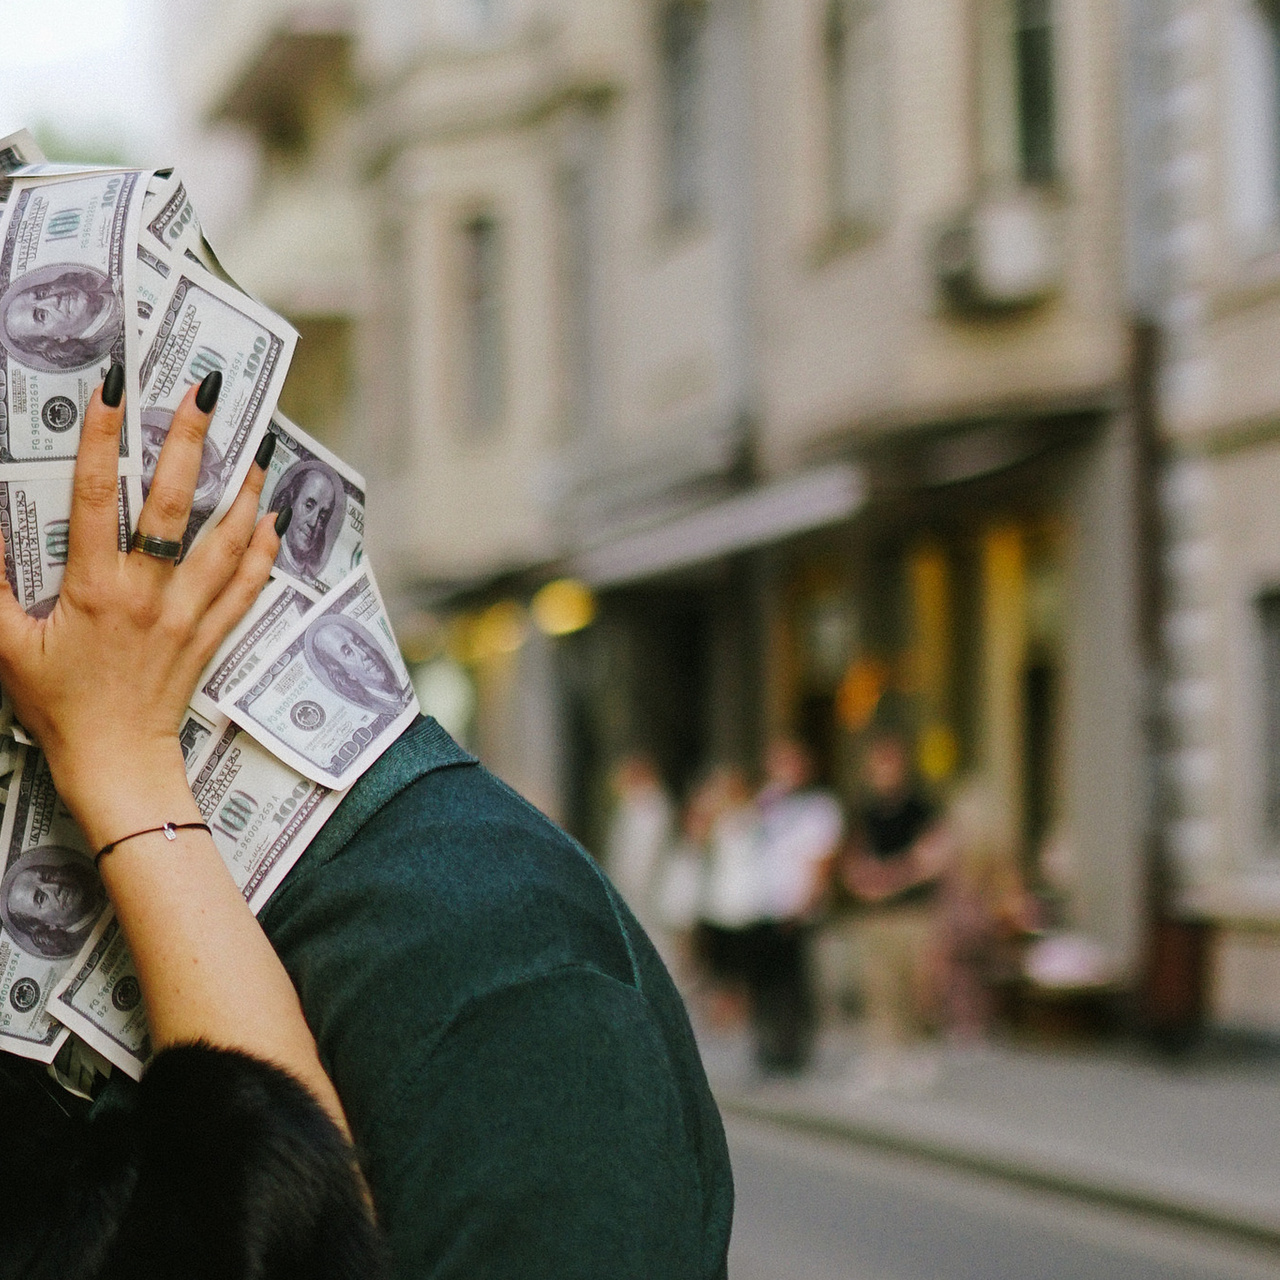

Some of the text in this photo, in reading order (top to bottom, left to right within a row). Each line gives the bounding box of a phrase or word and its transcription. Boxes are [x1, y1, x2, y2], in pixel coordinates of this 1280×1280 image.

[100, 177, 120, 208] 100
[240, 335, 268, 382] 100
[29, 382, 40, 436] 96003269
[224, 439, 241, 467] ONE
[235, 388, 262, 440] HUNDRED
[256, 341, 279, 389] DOLLARS
[30, 438, 40, 451] FG
[44, 437, 53, 450] B2
[14, 489, 30, 549] STATES
[26, 501, 41, 573] AMERICA
[209, 643, 249, 690] DOLLARS
[241, 651, 292, 704] 100
[330, 726, 373, 768] 100
[201, 763, 242, 823] AMERICA
[206, 746, 241, 800] STATES
[211, 788, 259, 841] 100
[271, 778, 310, 826] 100
[232, 794, 280, 861] FG 96003269 A
[249, 834, 289, 887] HUNDRED
[286, 786, 326, 835] DOLLARS
[2, 1012, 13, 1027] B2
[88, 997, 100, 1010] FG
[96, 1004, 108, 1018] B2
